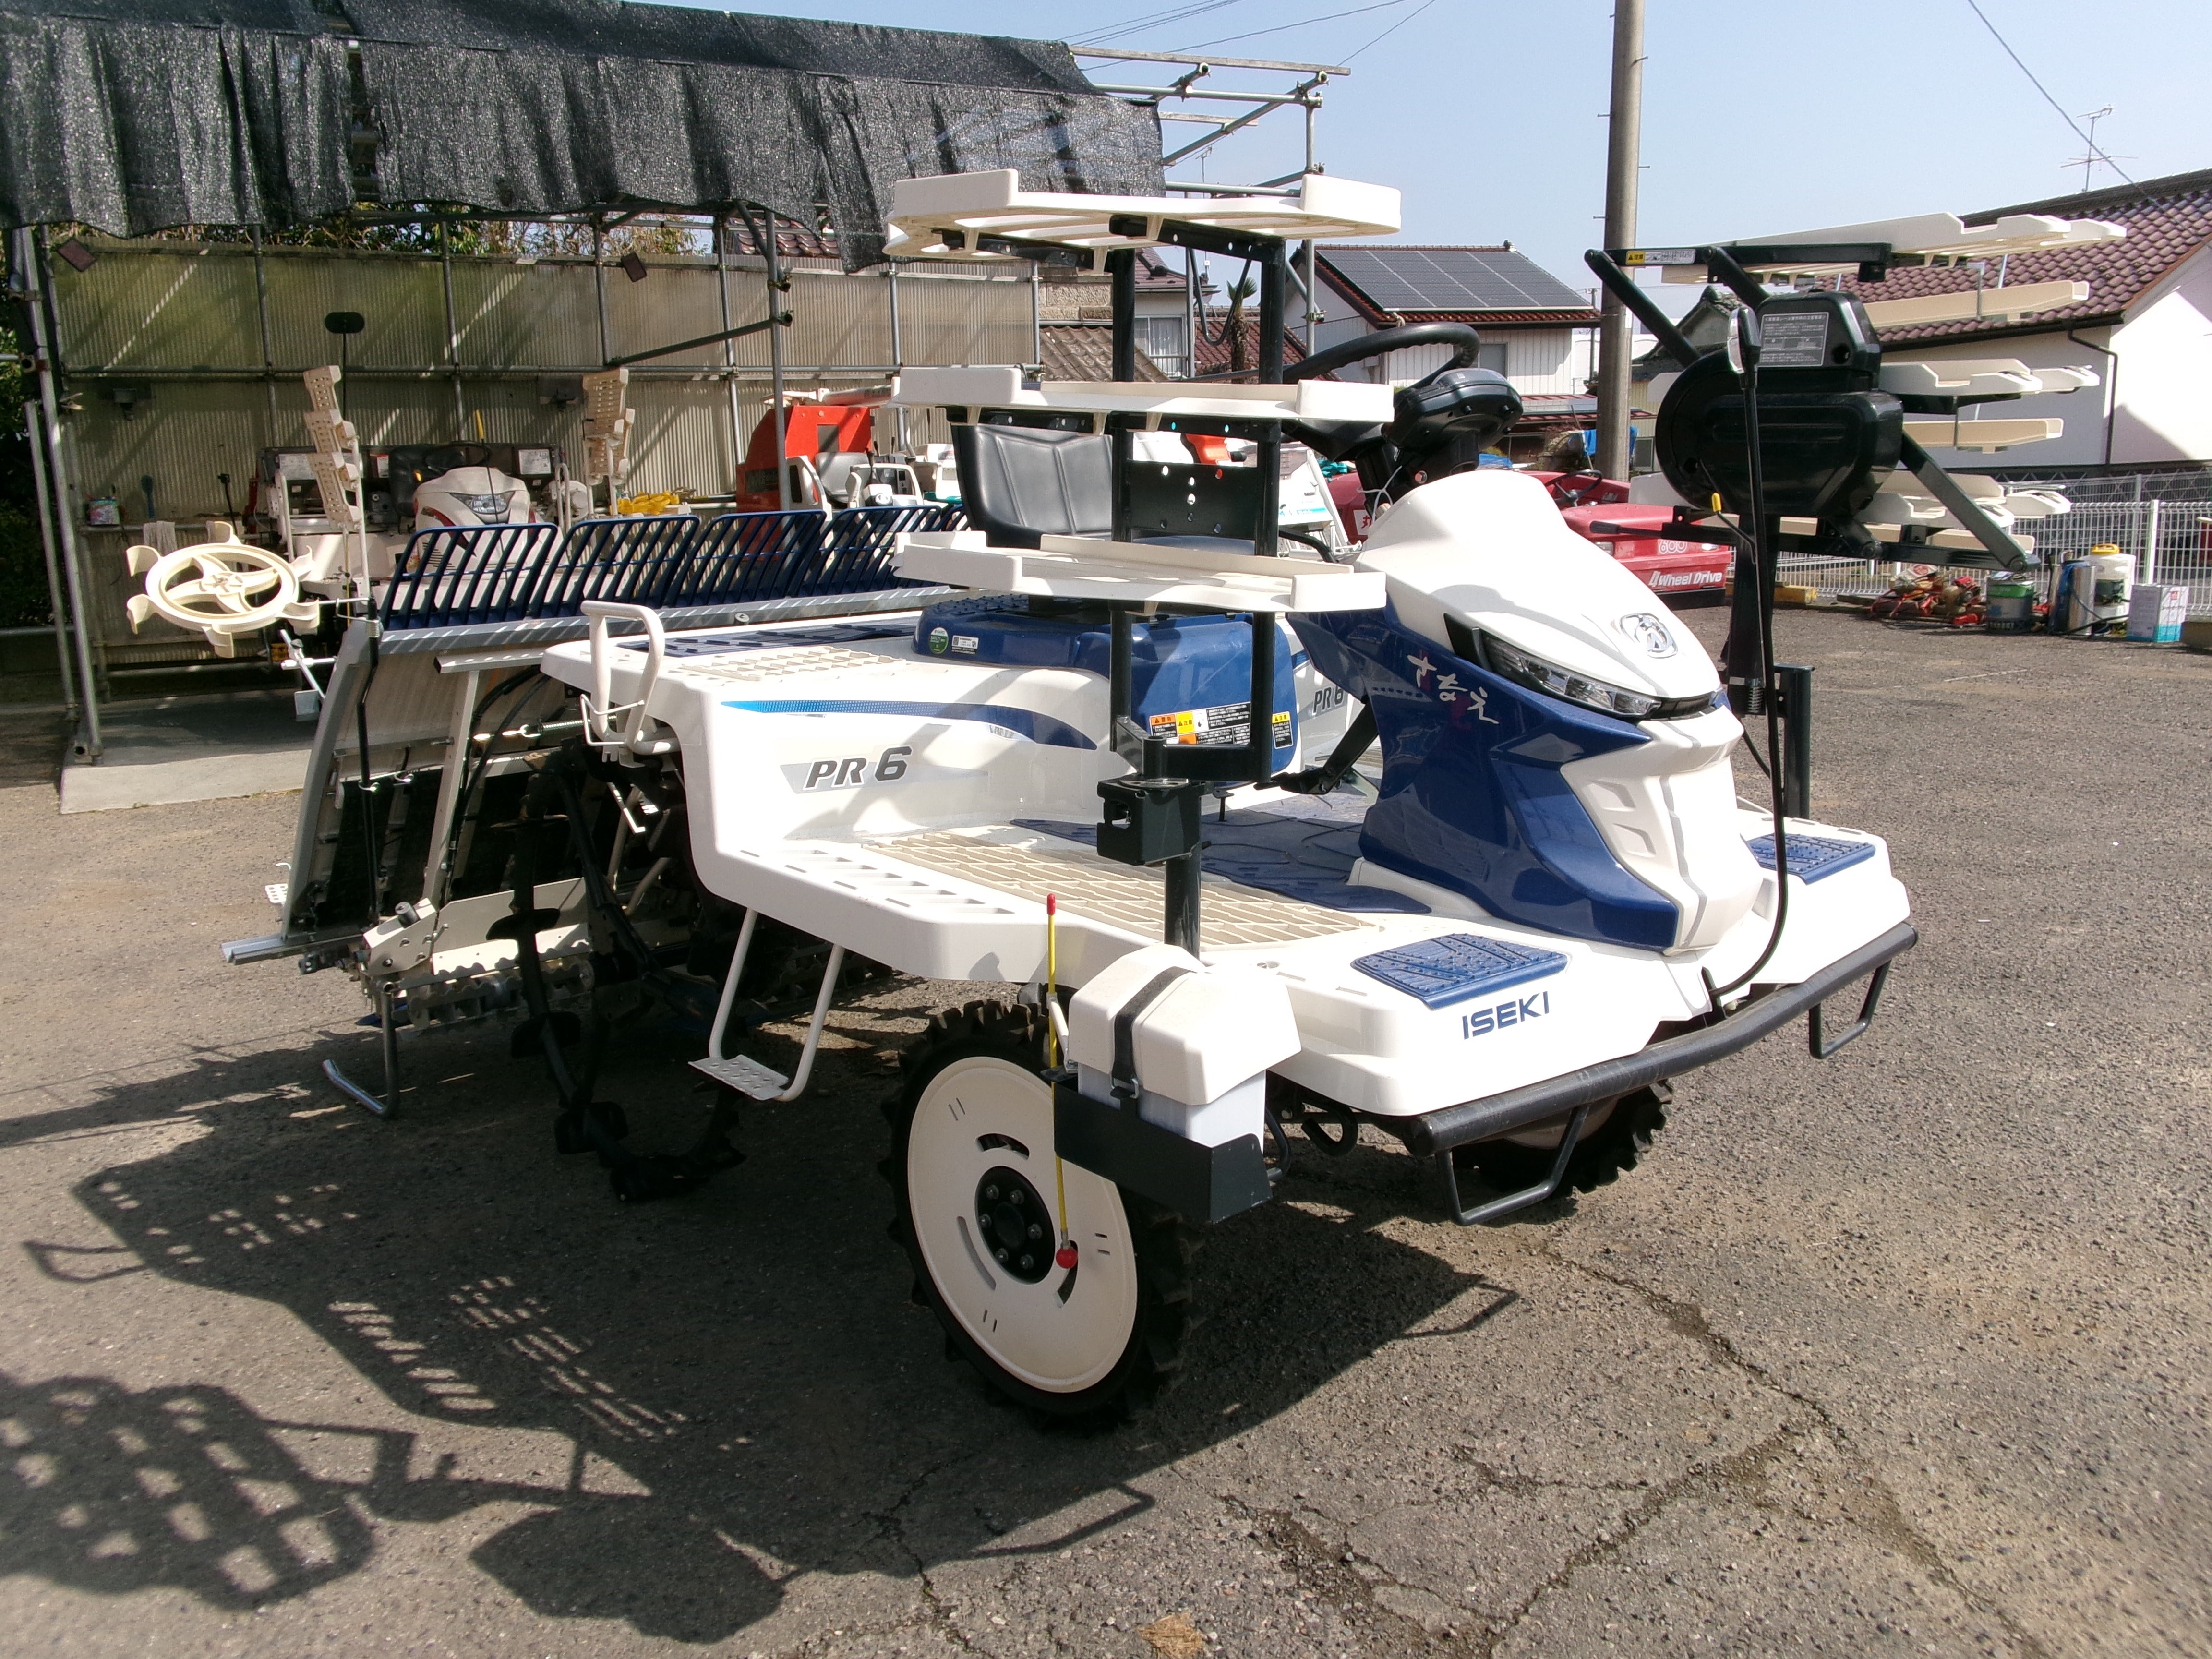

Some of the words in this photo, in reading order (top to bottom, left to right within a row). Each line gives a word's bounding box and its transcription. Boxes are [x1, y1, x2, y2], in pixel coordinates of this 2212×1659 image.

[1659, 541, 1688, 554] 600
[1693, 571, 1723, 584] Drive
[1313, 686, 1332, 714] PR
[1334, 685, 1344, 705] 6
[805, 757, 867, 789] PR
[875, 746, 912, 781] 6
[1462, 990, 1550, 1040] ISEKI
